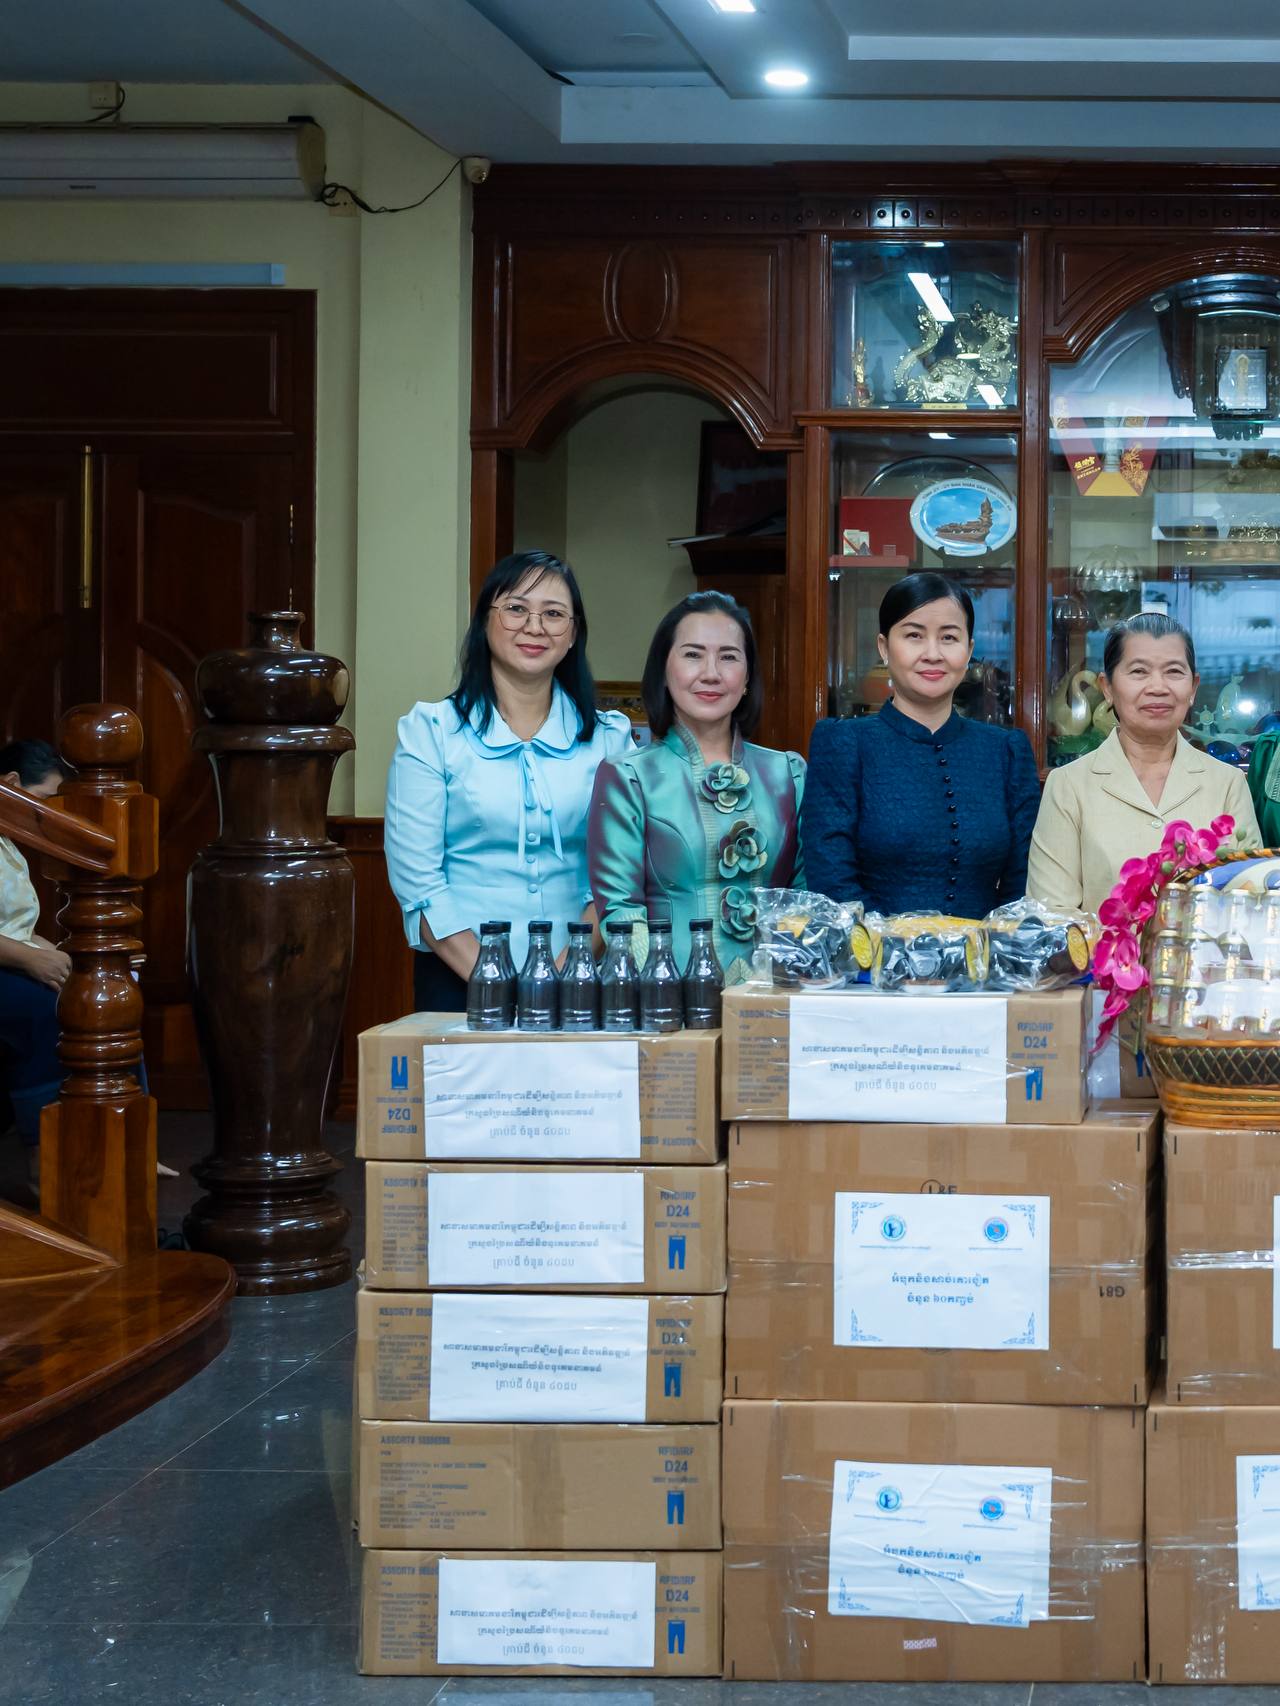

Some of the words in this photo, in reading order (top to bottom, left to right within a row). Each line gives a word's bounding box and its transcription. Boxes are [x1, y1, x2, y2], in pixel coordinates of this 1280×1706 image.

[1024, 1036, 1048, 1048] D24
[388, 1107, 411, 1120] D24
[667, 1205, 689, 1216] D24
[662, 1332, 686, 1344] D24
[665, 1460, 688, 1472] D24
[666, 1589, 688, 1601] D24
